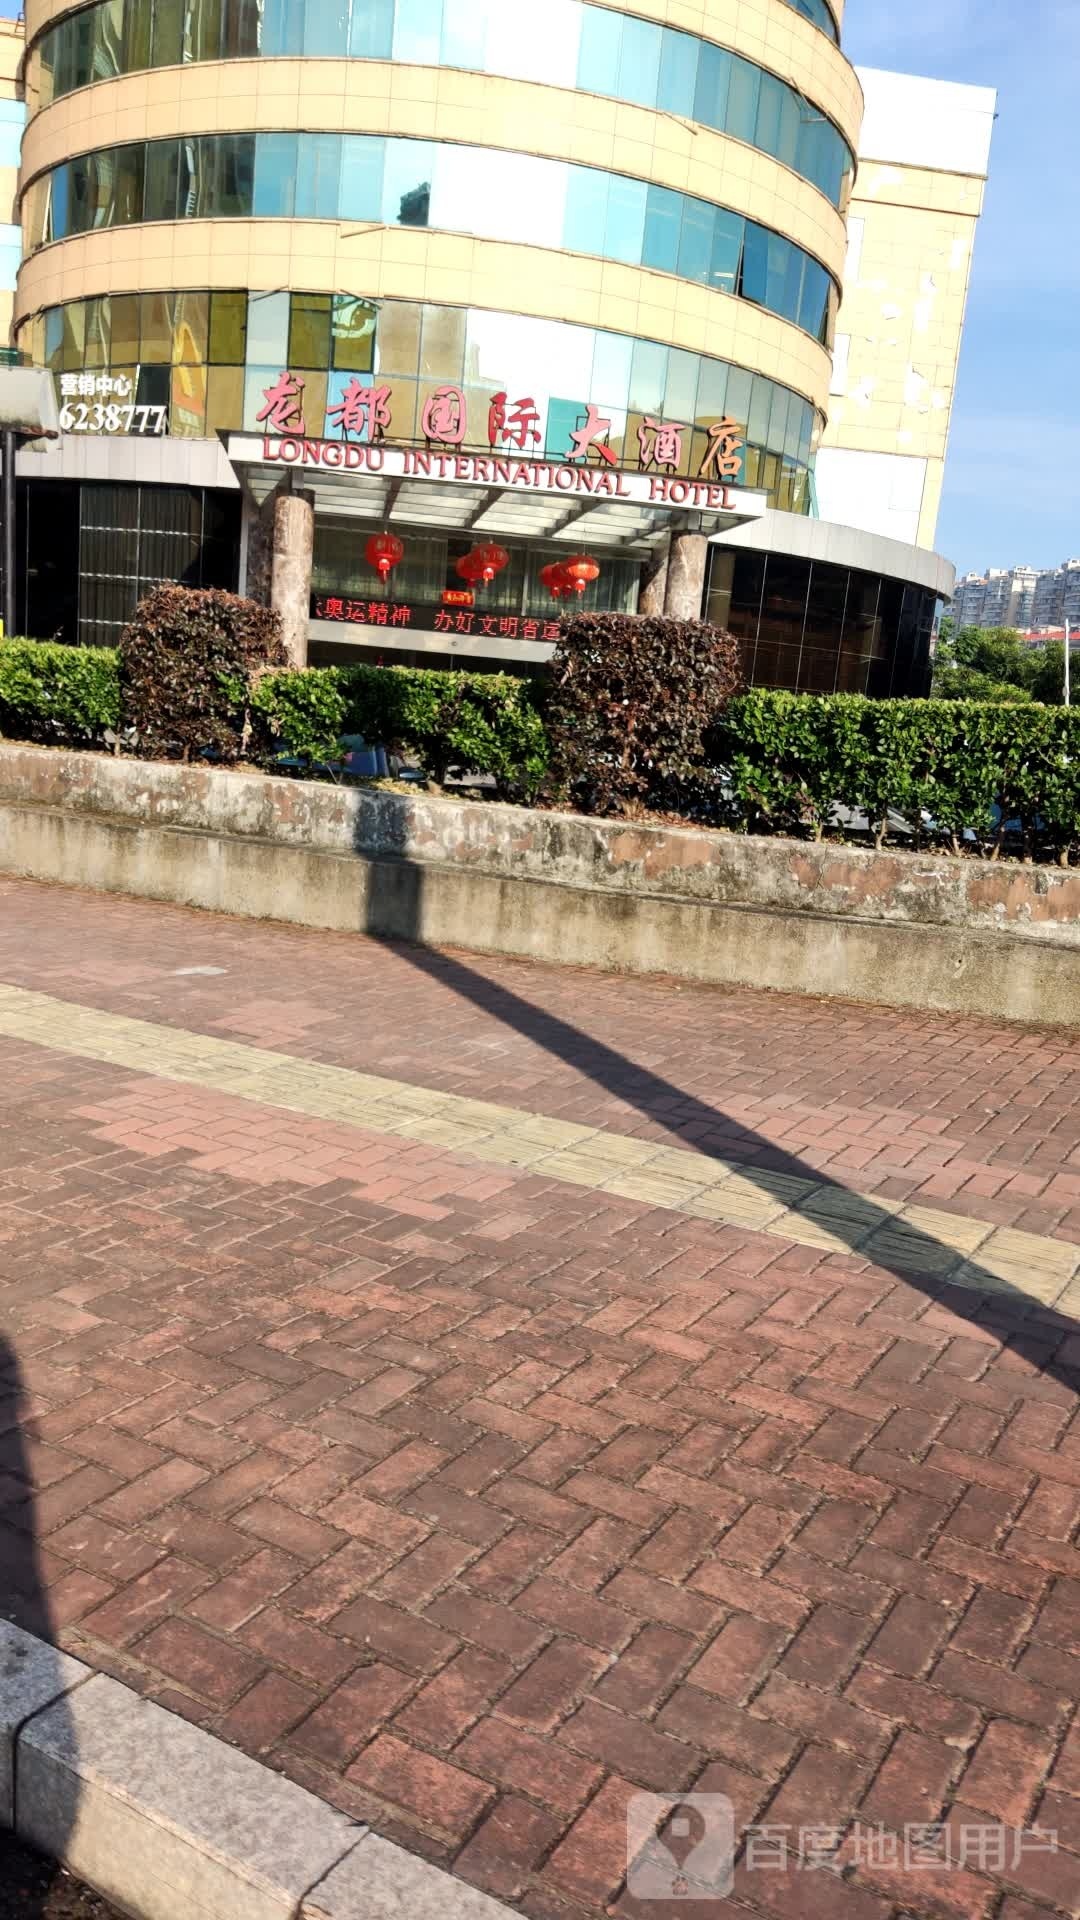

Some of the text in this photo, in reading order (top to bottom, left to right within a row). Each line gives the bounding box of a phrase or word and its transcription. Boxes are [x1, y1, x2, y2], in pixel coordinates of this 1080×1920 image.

[60, 373, 133, 396] 营销中心
[60, 402, 167, 433] 6238777
[256, 371, 743, 477] 龙都国际大酒店
[262, 436, 736, 510] LONGDU INTERNATIONAL HOTEL
[316, 597, 411, 627] 奥运精神
